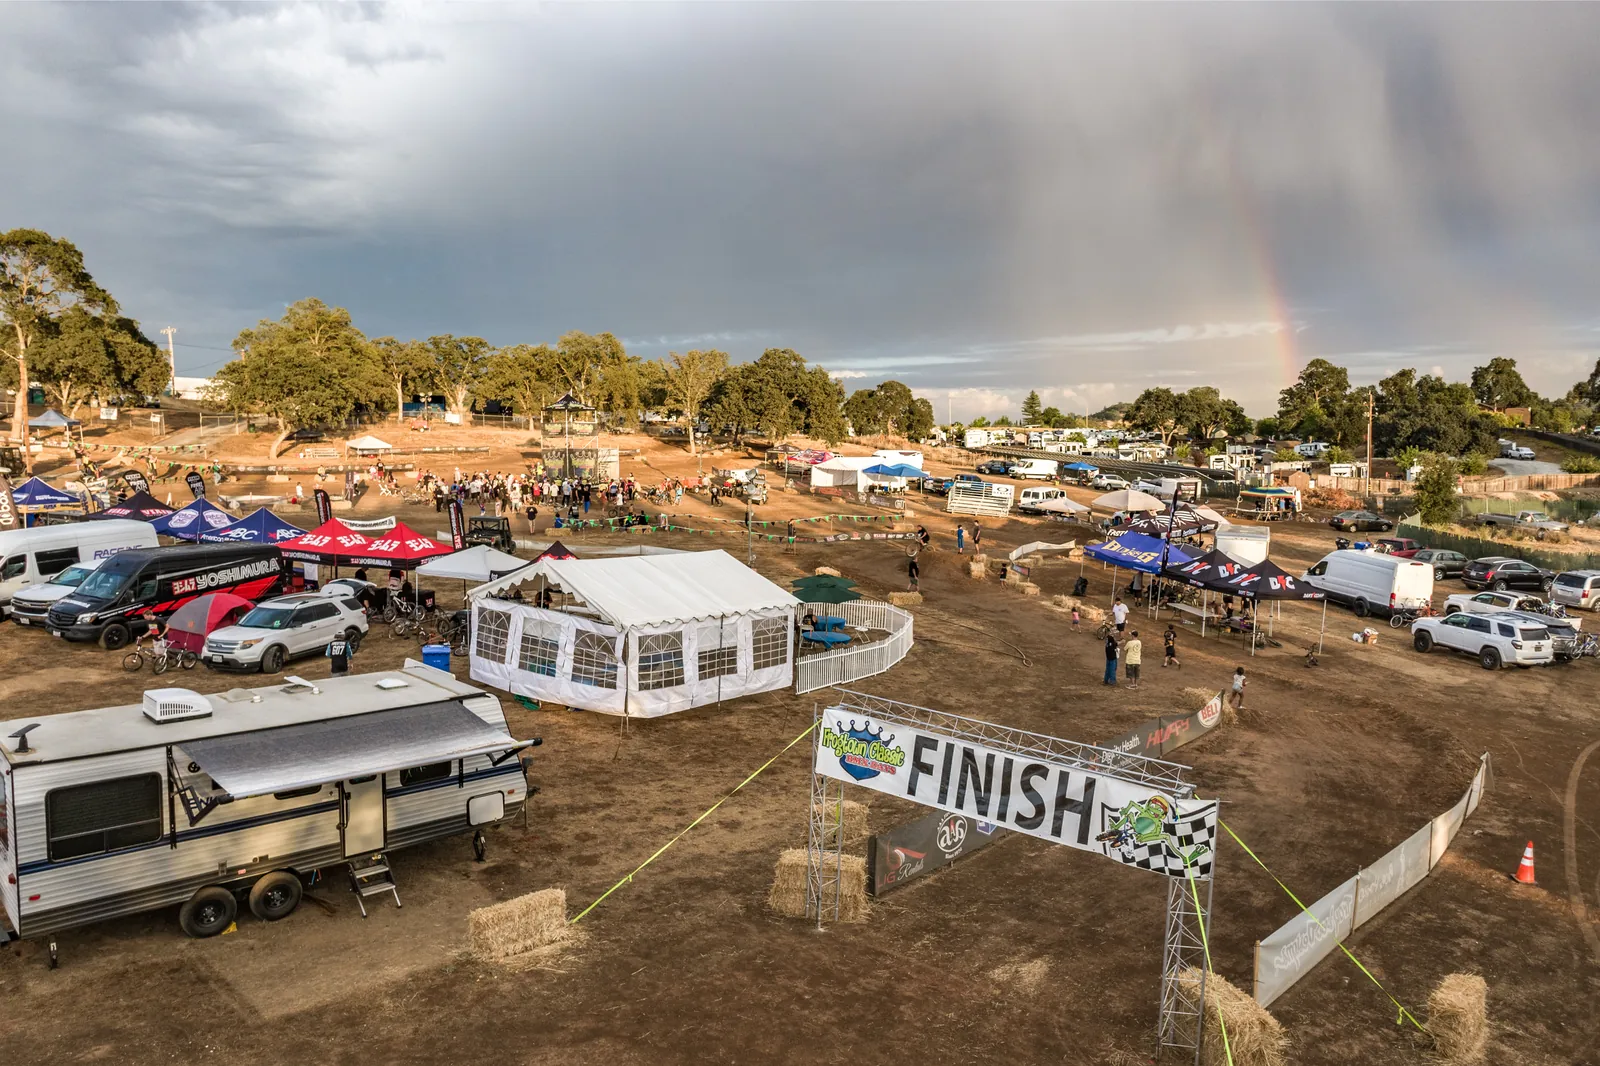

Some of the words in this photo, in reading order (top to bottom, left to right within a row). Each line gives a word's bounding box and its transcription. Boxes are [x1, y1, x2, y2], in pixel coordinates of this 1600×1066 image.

[220, 528, 258, 540] ABC
[196, 558, 280, 590] YOSHIMURA
[1200, 702, 1219, 720] BELL
[822, 727, 868, 758] Frogtown
[869, 740, 906, 767] Classic
[1146, 718, 1190, 749] HUFFY
[846, 754, 868, 767] BMX
[907, 734, 1097, 846] FINISH
